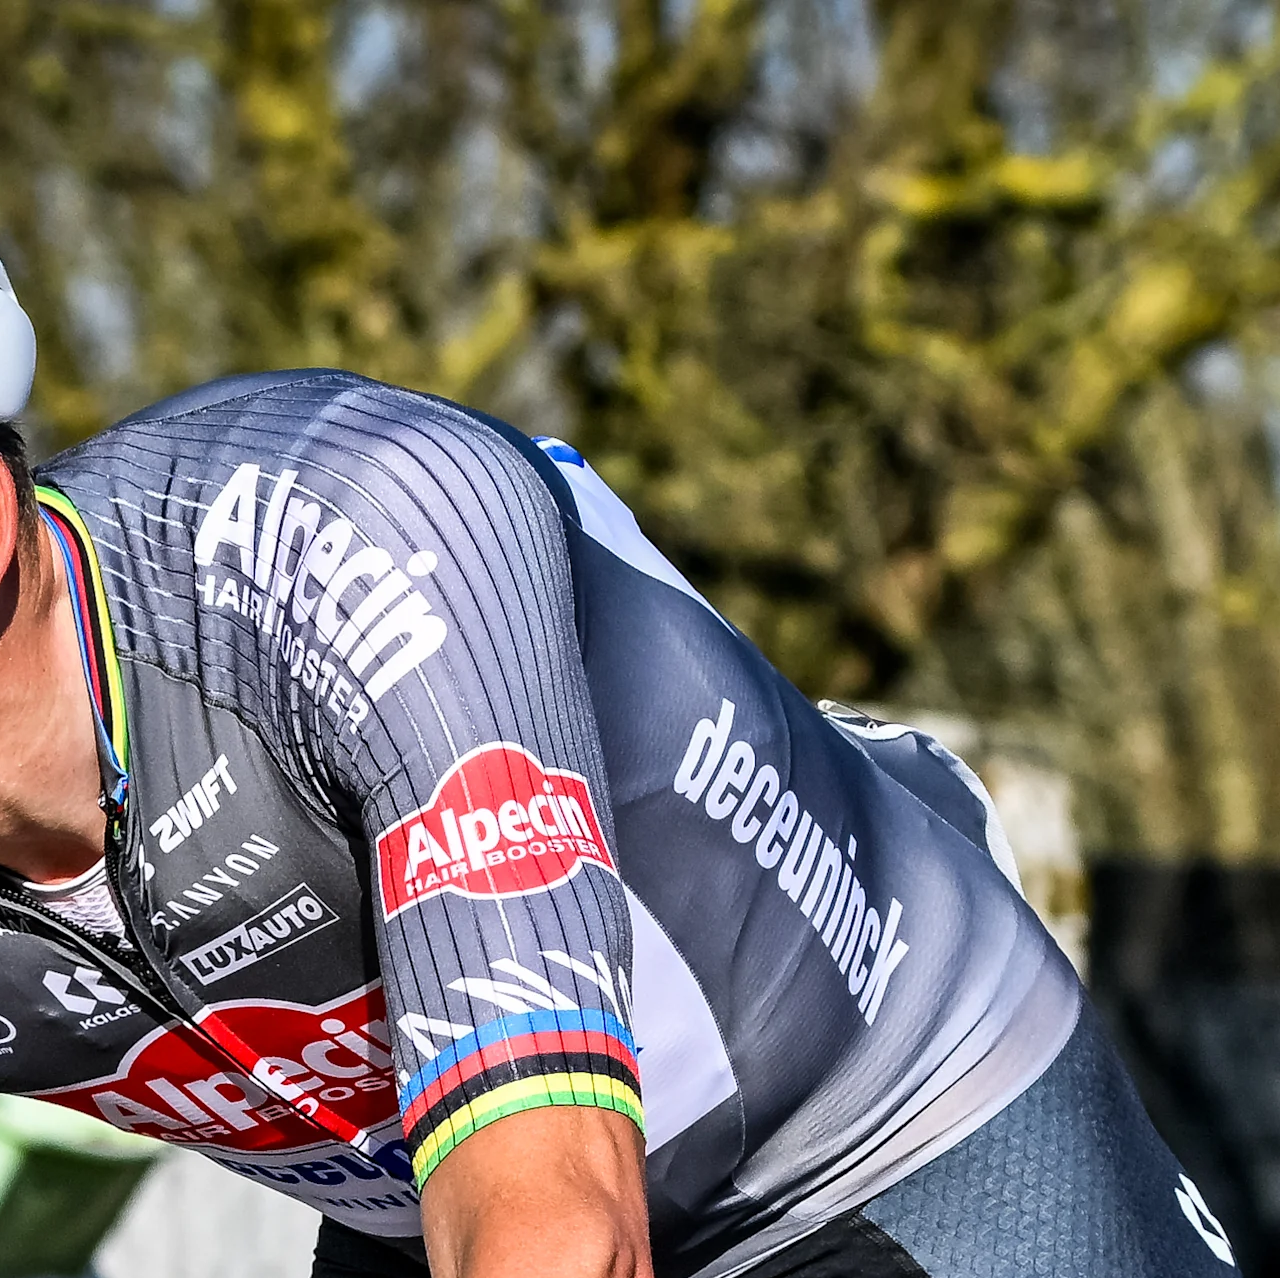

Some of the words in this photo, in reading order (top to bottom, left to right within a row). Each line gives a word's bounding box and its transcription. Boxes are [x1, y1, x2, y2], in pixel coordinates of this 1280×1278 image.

[194, 463, 448, 701] Alpecin
[148, 753, 238, 854] ZWIFT
[403, 781, 594, 882] Alpecin
[405, 860, 470, 896] HAIR
[486, 836, 602, 872] BOOSTER
[673, 697, 910, 1027] deceuninck
[191, 895, 324, 978] LUXAUTO
